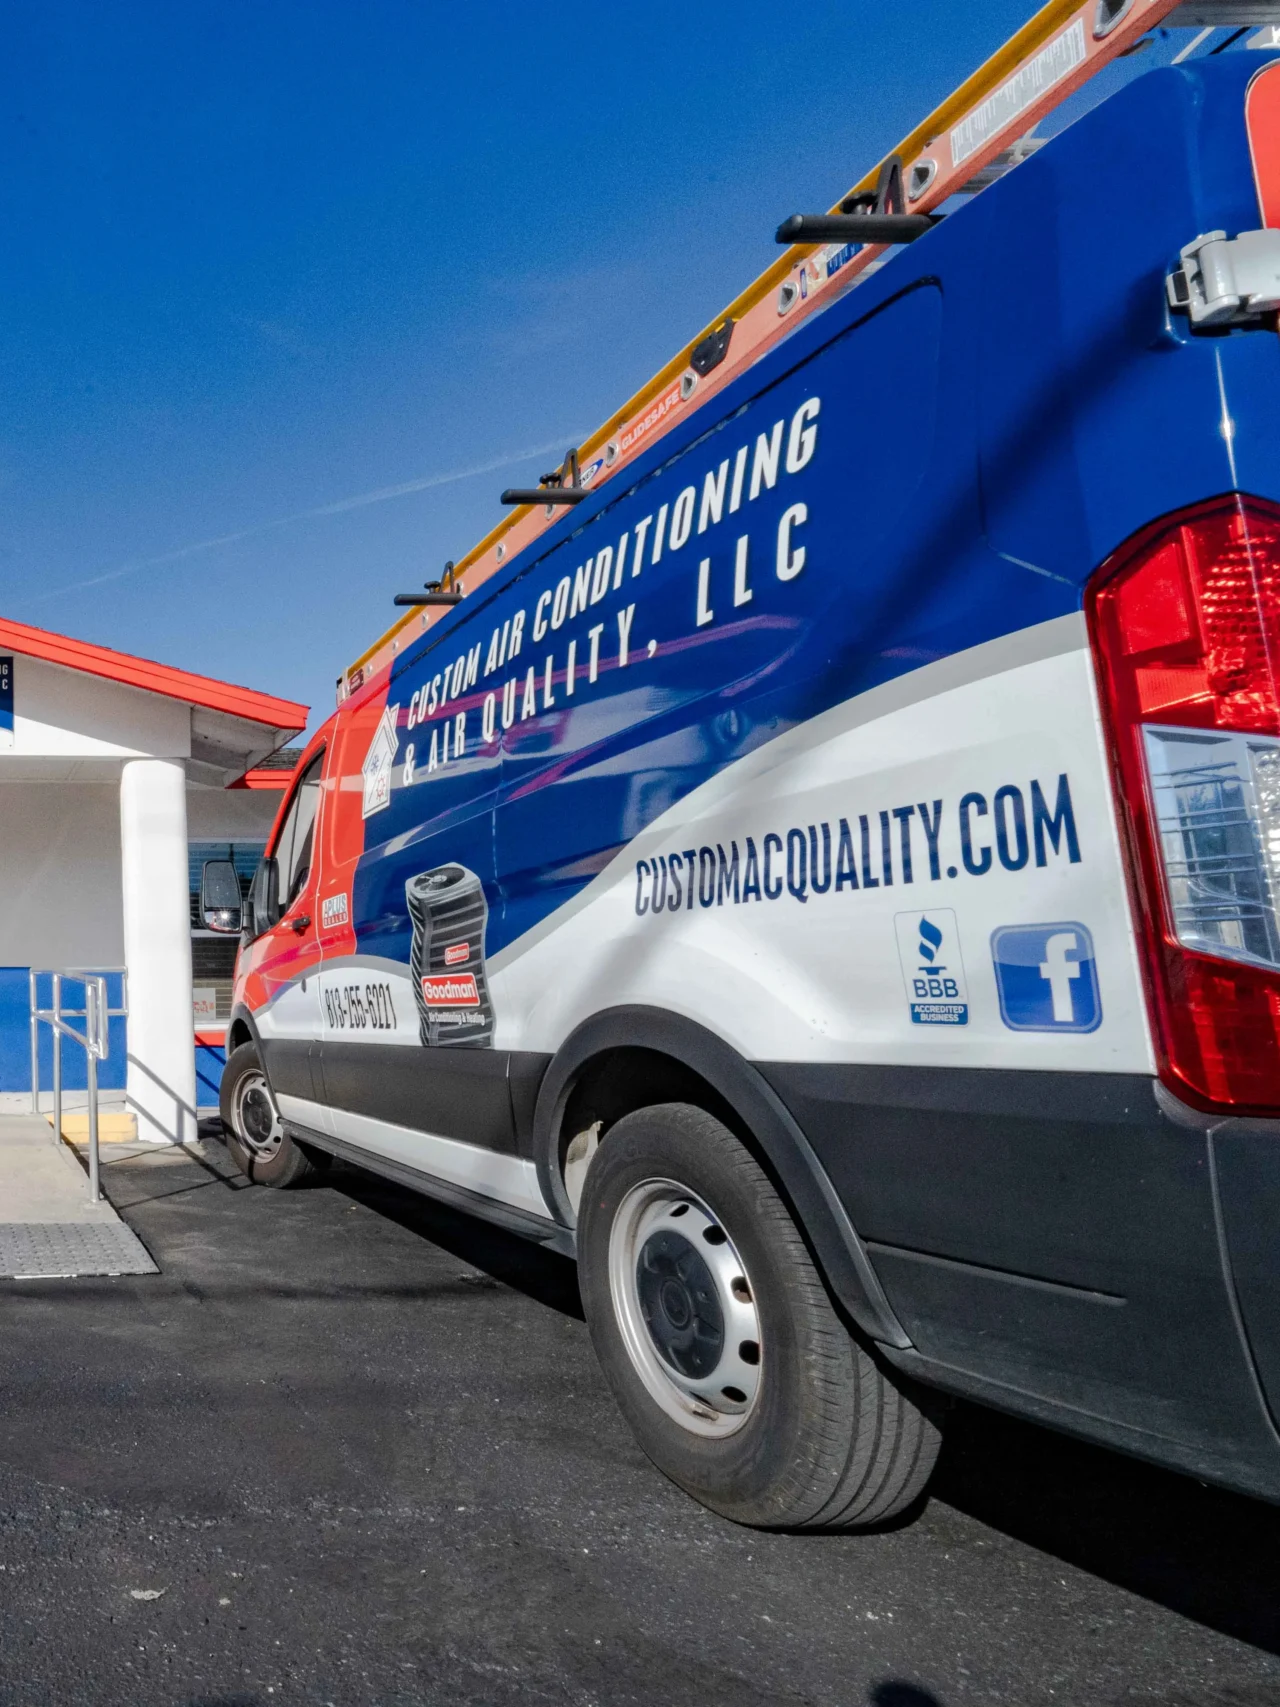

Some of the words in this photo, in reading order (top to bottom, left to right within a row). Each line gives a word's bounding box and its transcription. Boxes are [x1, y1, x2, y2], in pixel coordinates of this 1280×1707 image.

[622, 387, 680, 450] GLIDESAFE
[407, 641, 481, 731] CUSTOM
[484, 609, 526, 678] AIR
[533, 396, 821, 643] CONDITIONING
[402, 743, 416, 787] &
[427, 711, 466, 774] AIR
[482, 602, 658, 744] QUALITY,
[696, 502, 808, 628] LLC
[634, 772, 1083, 917] CUSTOMACQUALITY.COM
[325, 982, 398, 1030] 813-255-6221
[424, 980, 476, 1000] Goodman
[912, 978, 959, 998] BBB
[914, 1005, 965, 1014] ACCREDITED
[920, 1013, 960, 1022] BUSINESS
